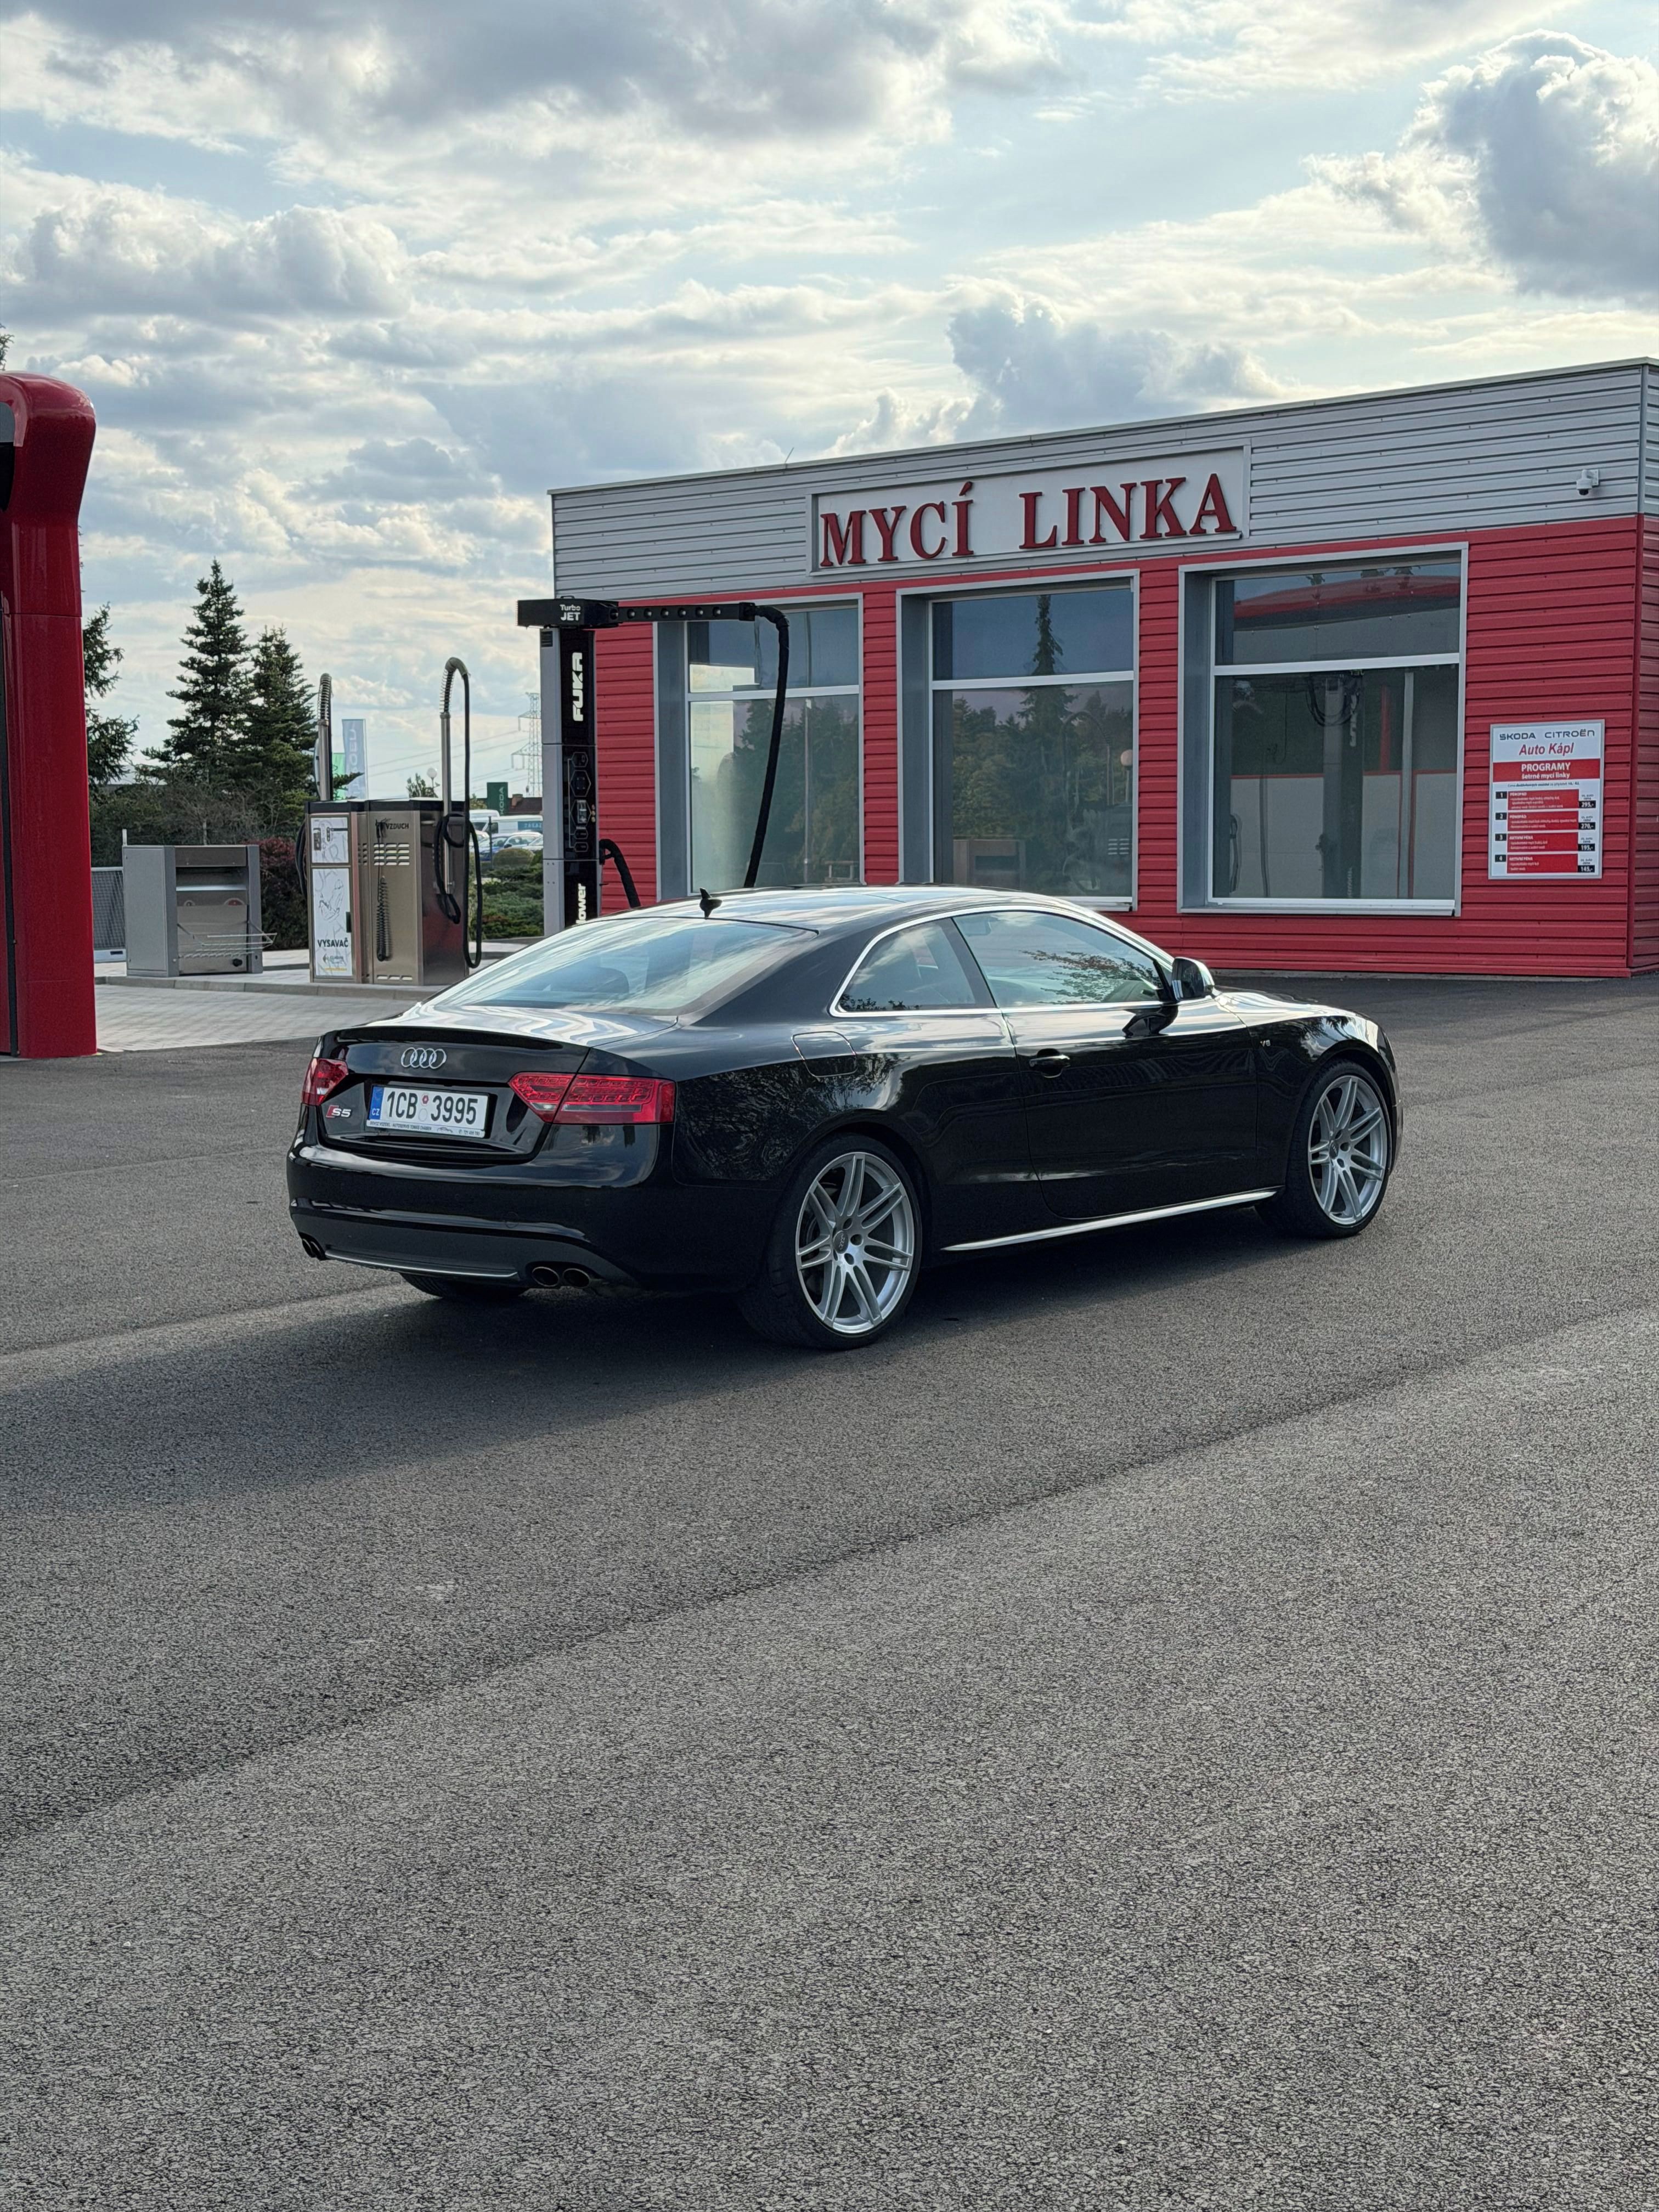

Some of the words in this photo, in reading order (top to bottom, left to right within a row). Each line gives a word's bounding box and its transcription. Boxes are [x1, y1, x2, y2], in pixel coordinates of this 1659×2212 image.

[820, 481, 974, 567] MYCÍ
[1018, 472, 1237, 550] LINKA
[560, 612, 581, 621] JET
[572, 652, 584, 721] FUKA
[1544, 729, 1595, 738] CITROËN
[1519, 744, 1545, 755] Auto
[1548, 742, 1575, 757] Kápl
[1521, 762, 1571, 772] PROGRAMY
[575, 883, 586, 924] lower
[318, 937, 348, 947] VYSAVAČ
[331, 1108, 352, 1118] S5
[387, 1091, 418, 1119] 1CB
[431, 1095, 478, 1125] 3995
